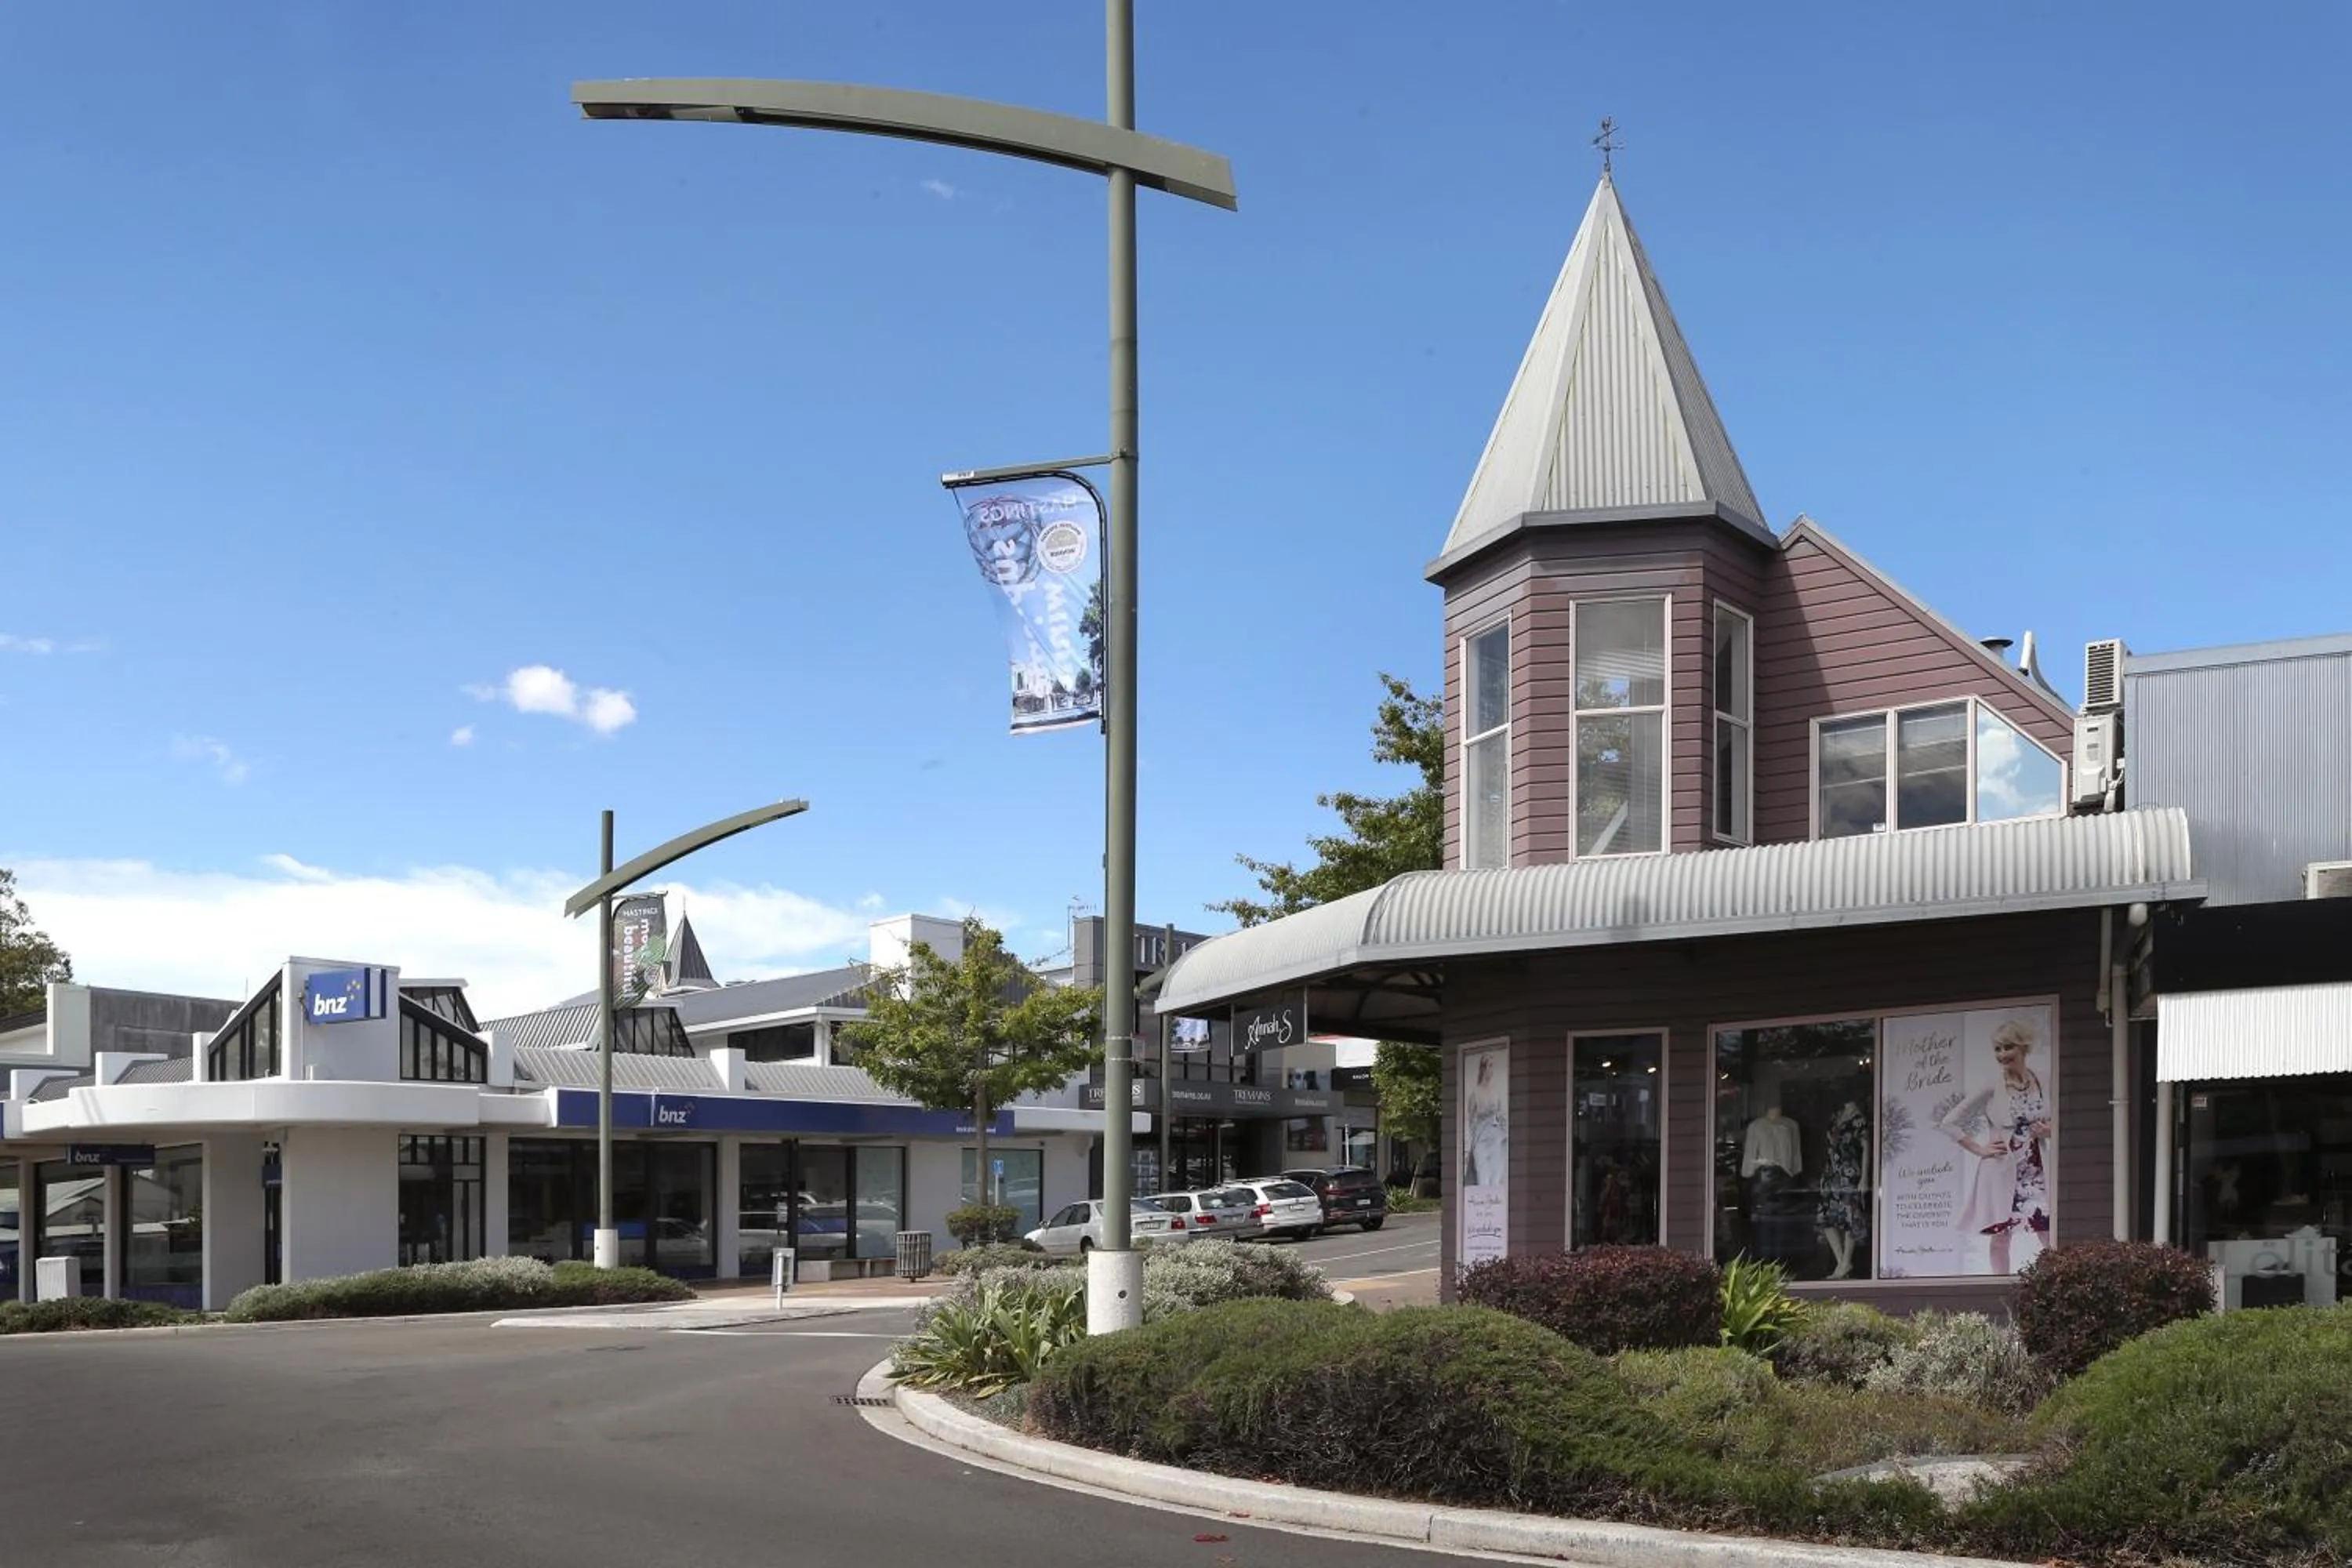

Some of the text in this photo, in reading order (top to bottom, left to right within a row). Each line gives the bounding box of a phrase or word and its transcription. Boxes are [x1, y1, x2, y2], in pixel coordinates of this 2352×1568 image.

[623, 924, 640, 999] beautiful
[313, 993, 347, 1016] bnz
[1244, 1009, 1293, 1050] Annah S
[1895, 1030, 1958, 1058] Mother
[1913, 1051, 1950, 1070] of the
[1905, 1065, 1953, 1092] Bride
[659, 1104, 687, 1123] bnz
[74, 1150, 101, 1163] bnz
